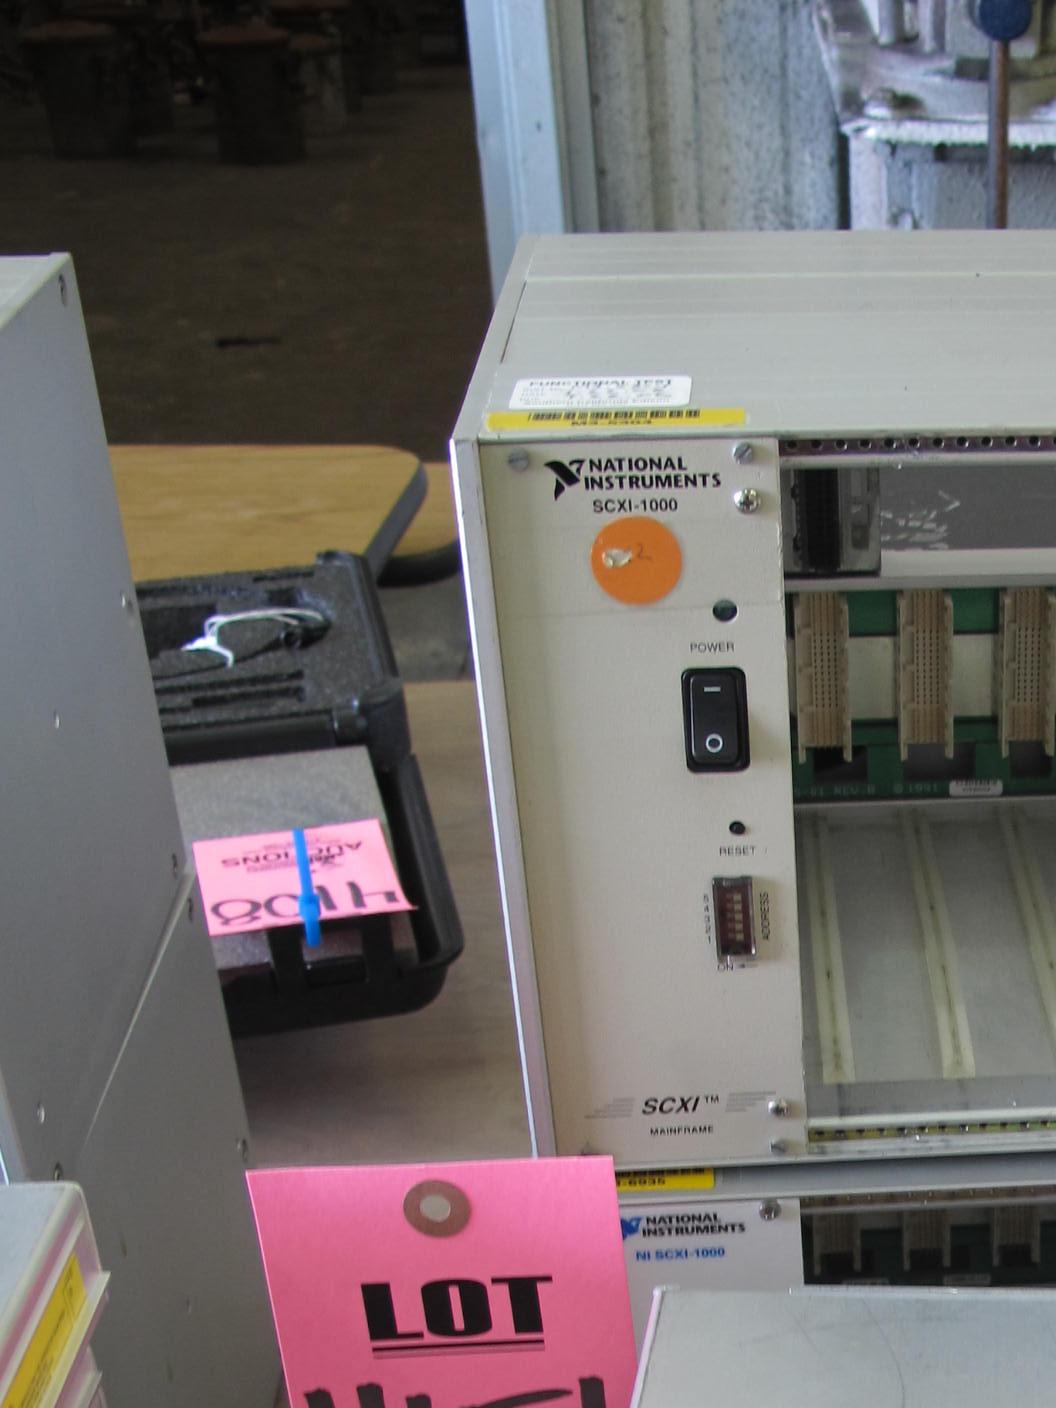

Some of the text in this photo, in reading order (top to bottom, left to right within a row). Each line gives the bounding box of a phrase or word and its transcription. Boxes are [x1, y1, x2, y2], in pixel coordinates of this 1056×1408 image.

[589, 457, 688, 472] NATIONAL
[584, 473, 722, 491] INSTRUMENTS
[593, 498, 680, 513] SCXI-1000
[690, 642, 735, 654] POWER
[719, 846, 755, 857] RESET
[760, 891, 770, 941] ADDRESS
[650, 1124, 714, 1137] MAINFRAME
[646, 1212, 720, 1225] NATIONAL
[642, 1223, 746, 1238] INSTRUMENTS
[636, 1247, 725, 1261] NI SCXI-1000
[361, 1275, 553, 1341] LOT
